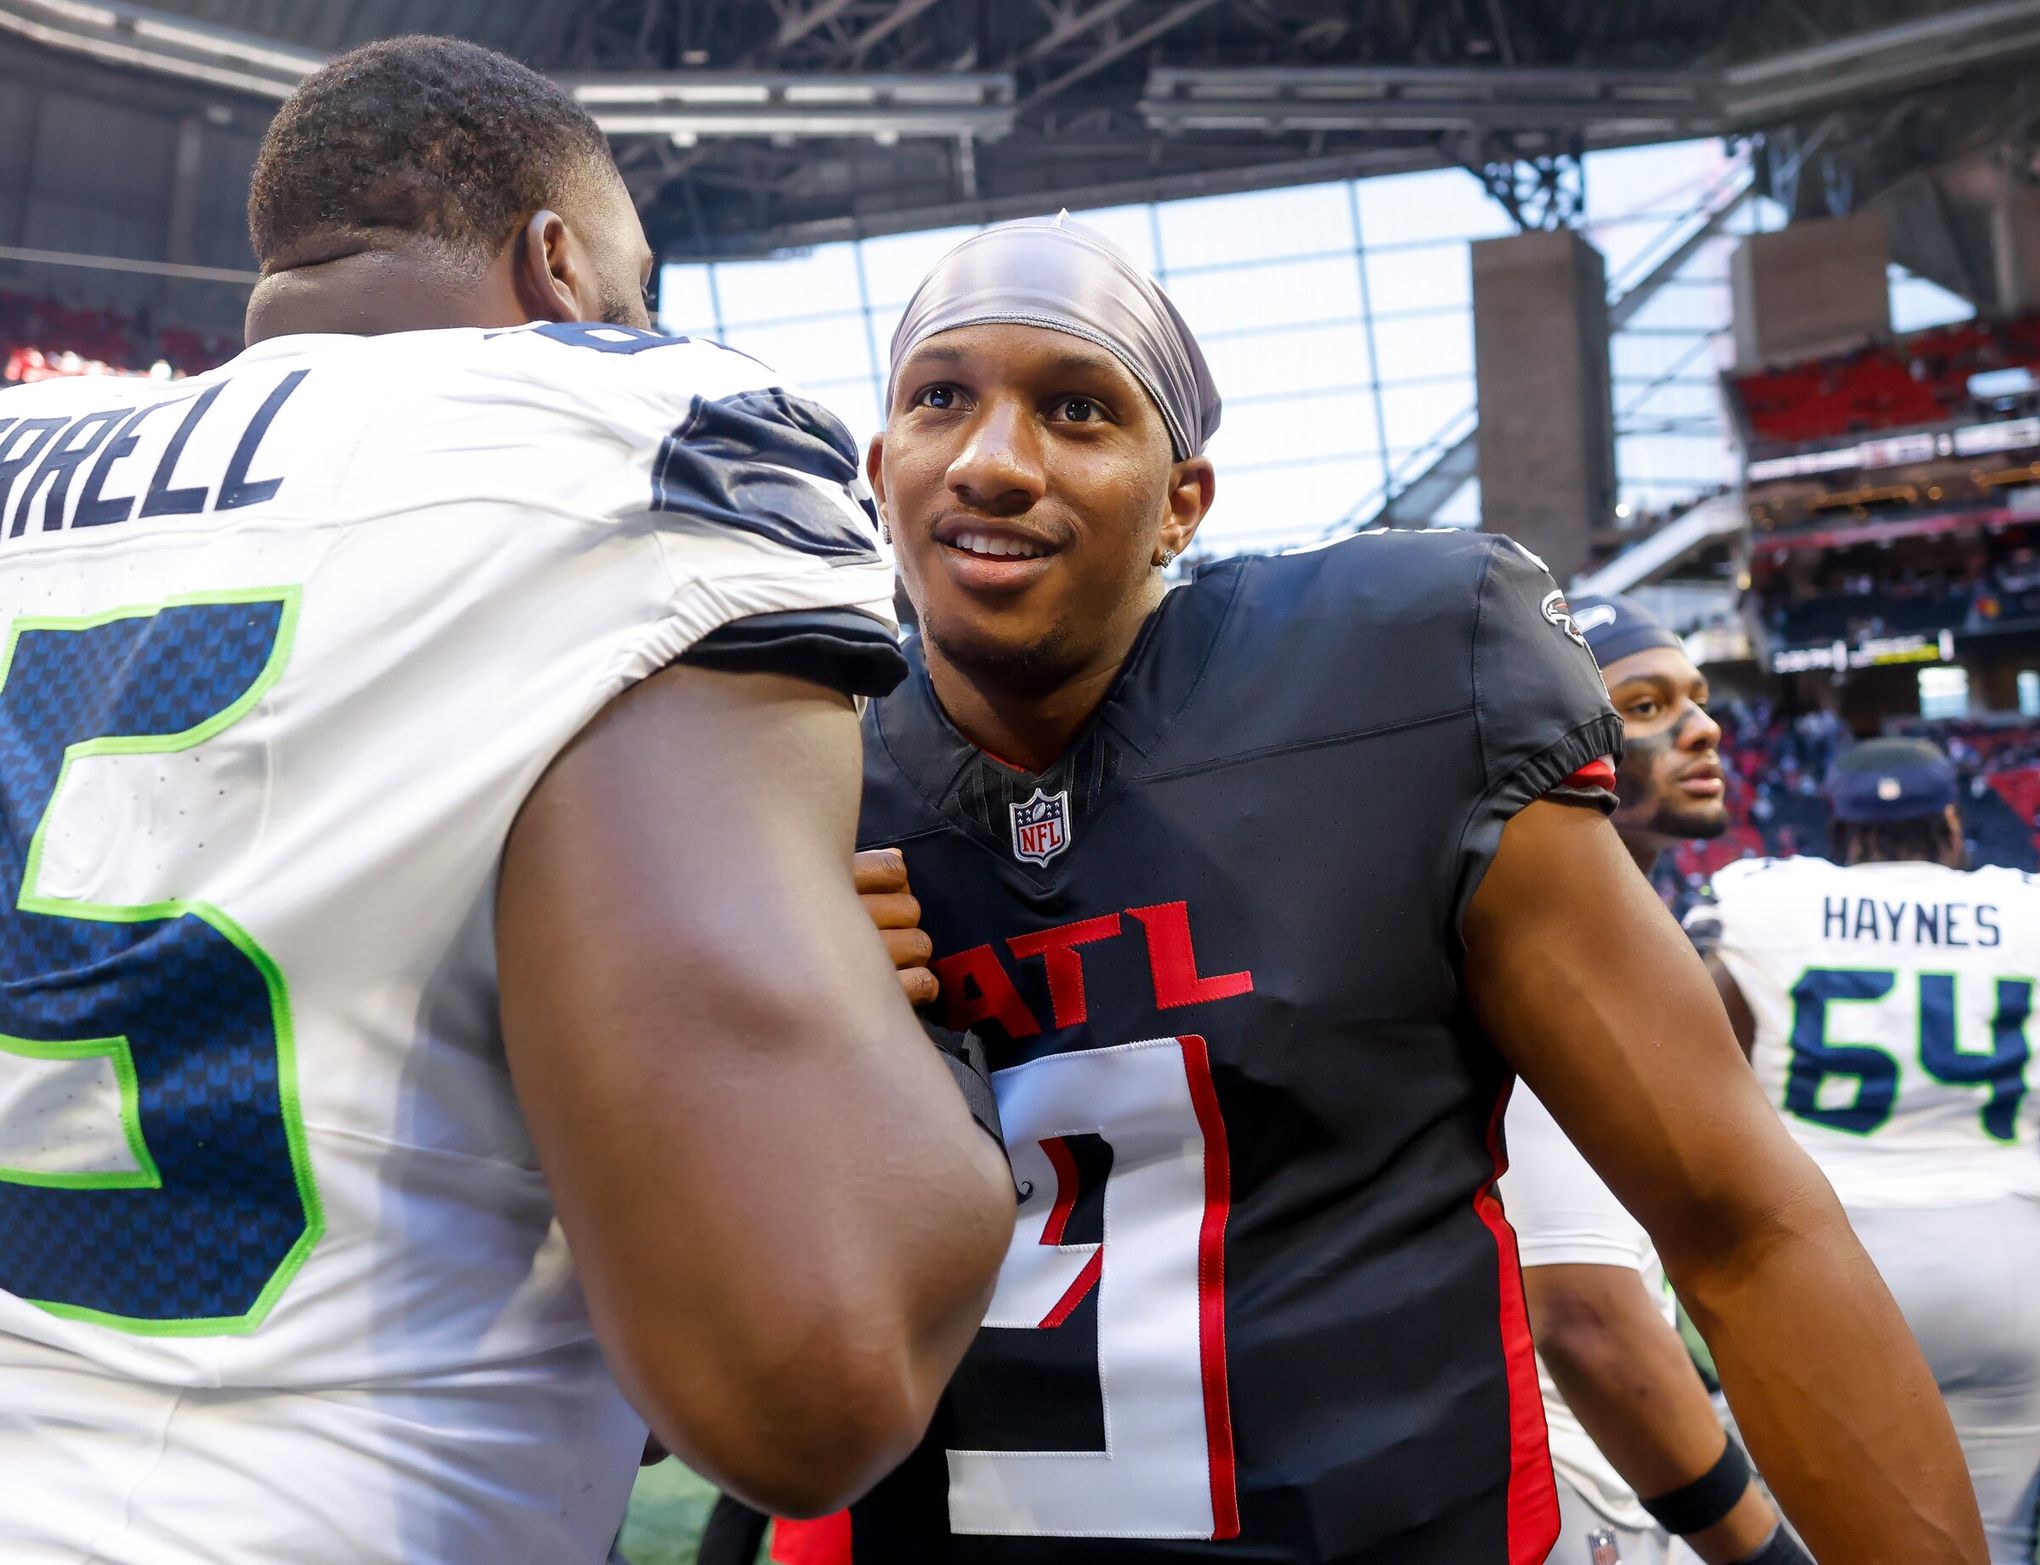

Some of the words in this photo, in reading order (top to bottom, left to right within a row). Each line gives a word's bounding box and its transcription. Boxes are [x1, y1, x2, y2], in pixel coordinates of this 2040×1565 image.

[0, 368, 311, 539] RRELL
[1020, 821, 1061, 853] NFL
[0, 583, 326, 1336] 5
[931, 900, 1254, 1039] ATL
[1823, 896, 2002, 947] HAYNES
[1781, 964, 2037, 1147] 64
